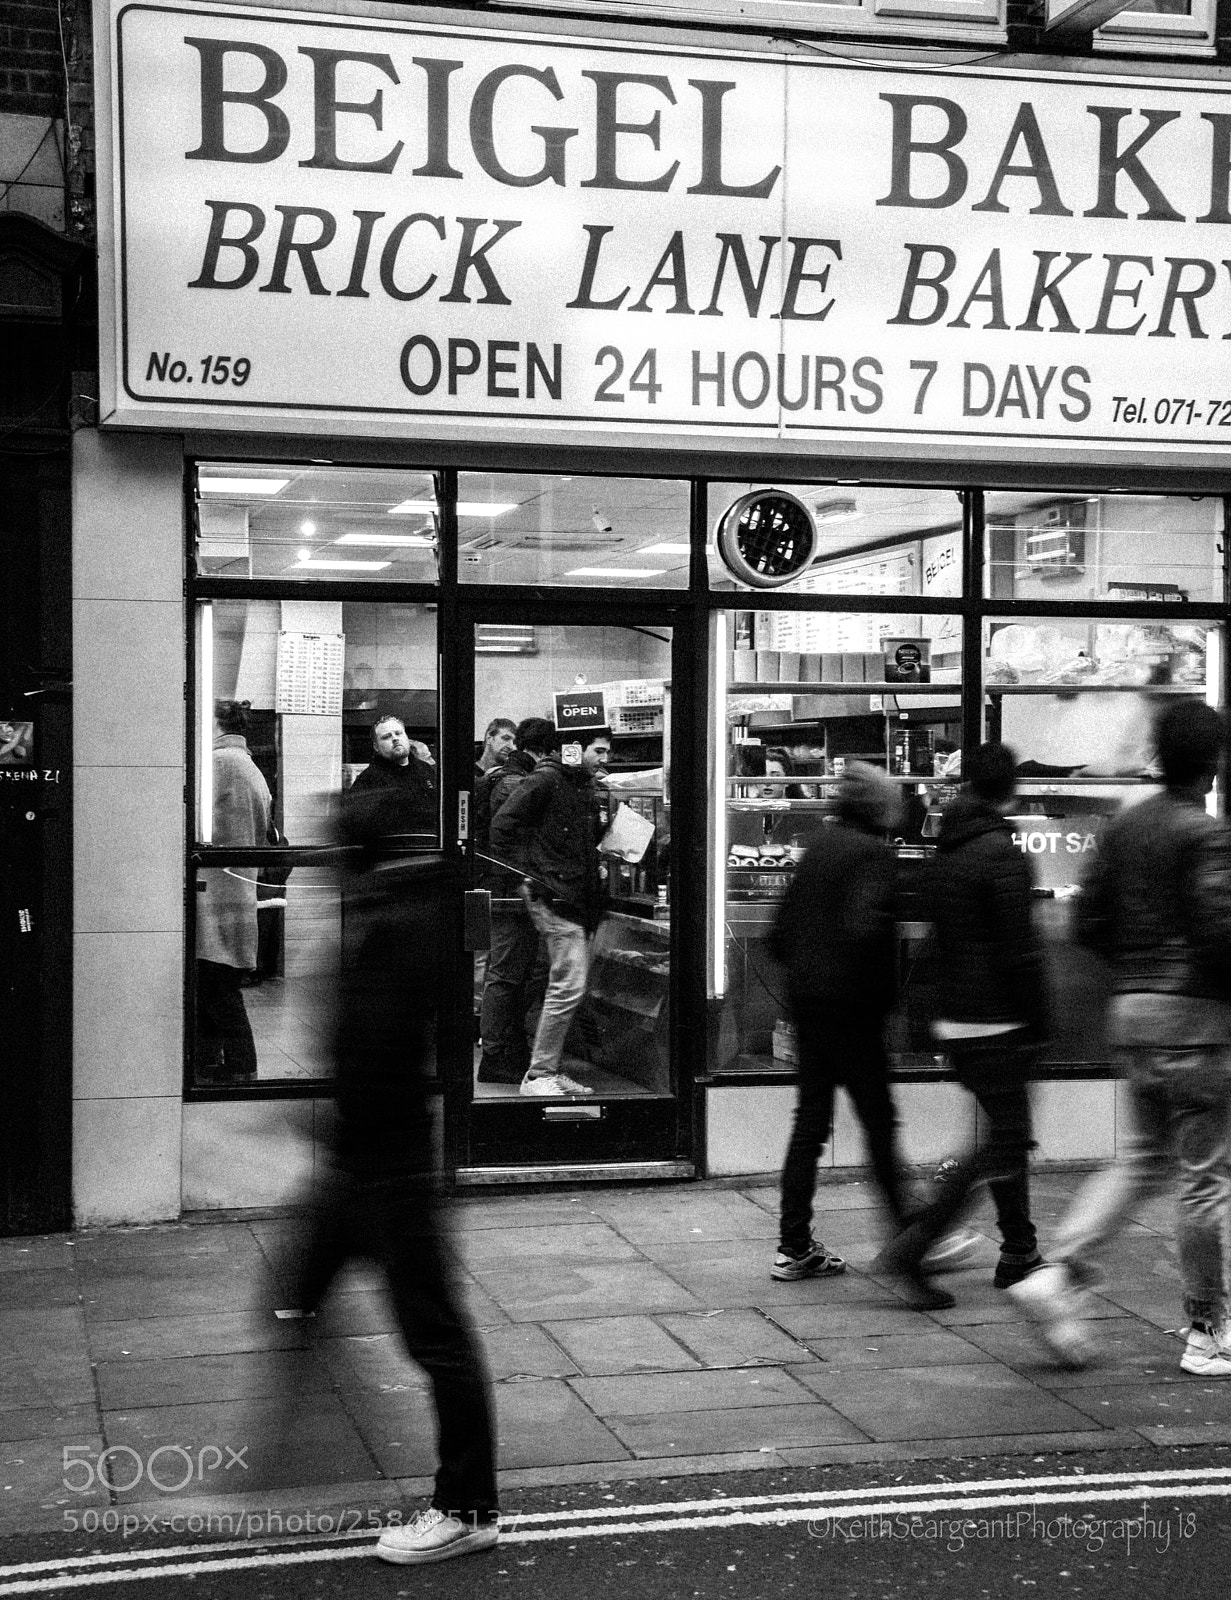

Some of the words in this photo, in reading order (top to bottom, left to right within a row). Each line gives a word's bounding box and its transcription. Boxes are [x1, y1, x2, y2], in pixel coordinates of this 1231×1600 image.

[184, 36, 783, 200] BEIGEL
[187, 199, 522, 306] BRICK
[566, 224, 843, 322] LANE
[400, 335, 563, 400] OPEN
[594, 345, 663, 404] 24
[691, 350, 884, 415] HOURS
[909, 360, 939, 415] 7
[962, 362, 1092, 423] DAYS
[1112, 396, 1148, 424] Tel.
[562, 706, 598, 717] OPEN
[459, 798, 467, 832] PUSH
[1011, 832, 1062, 853] HOT
